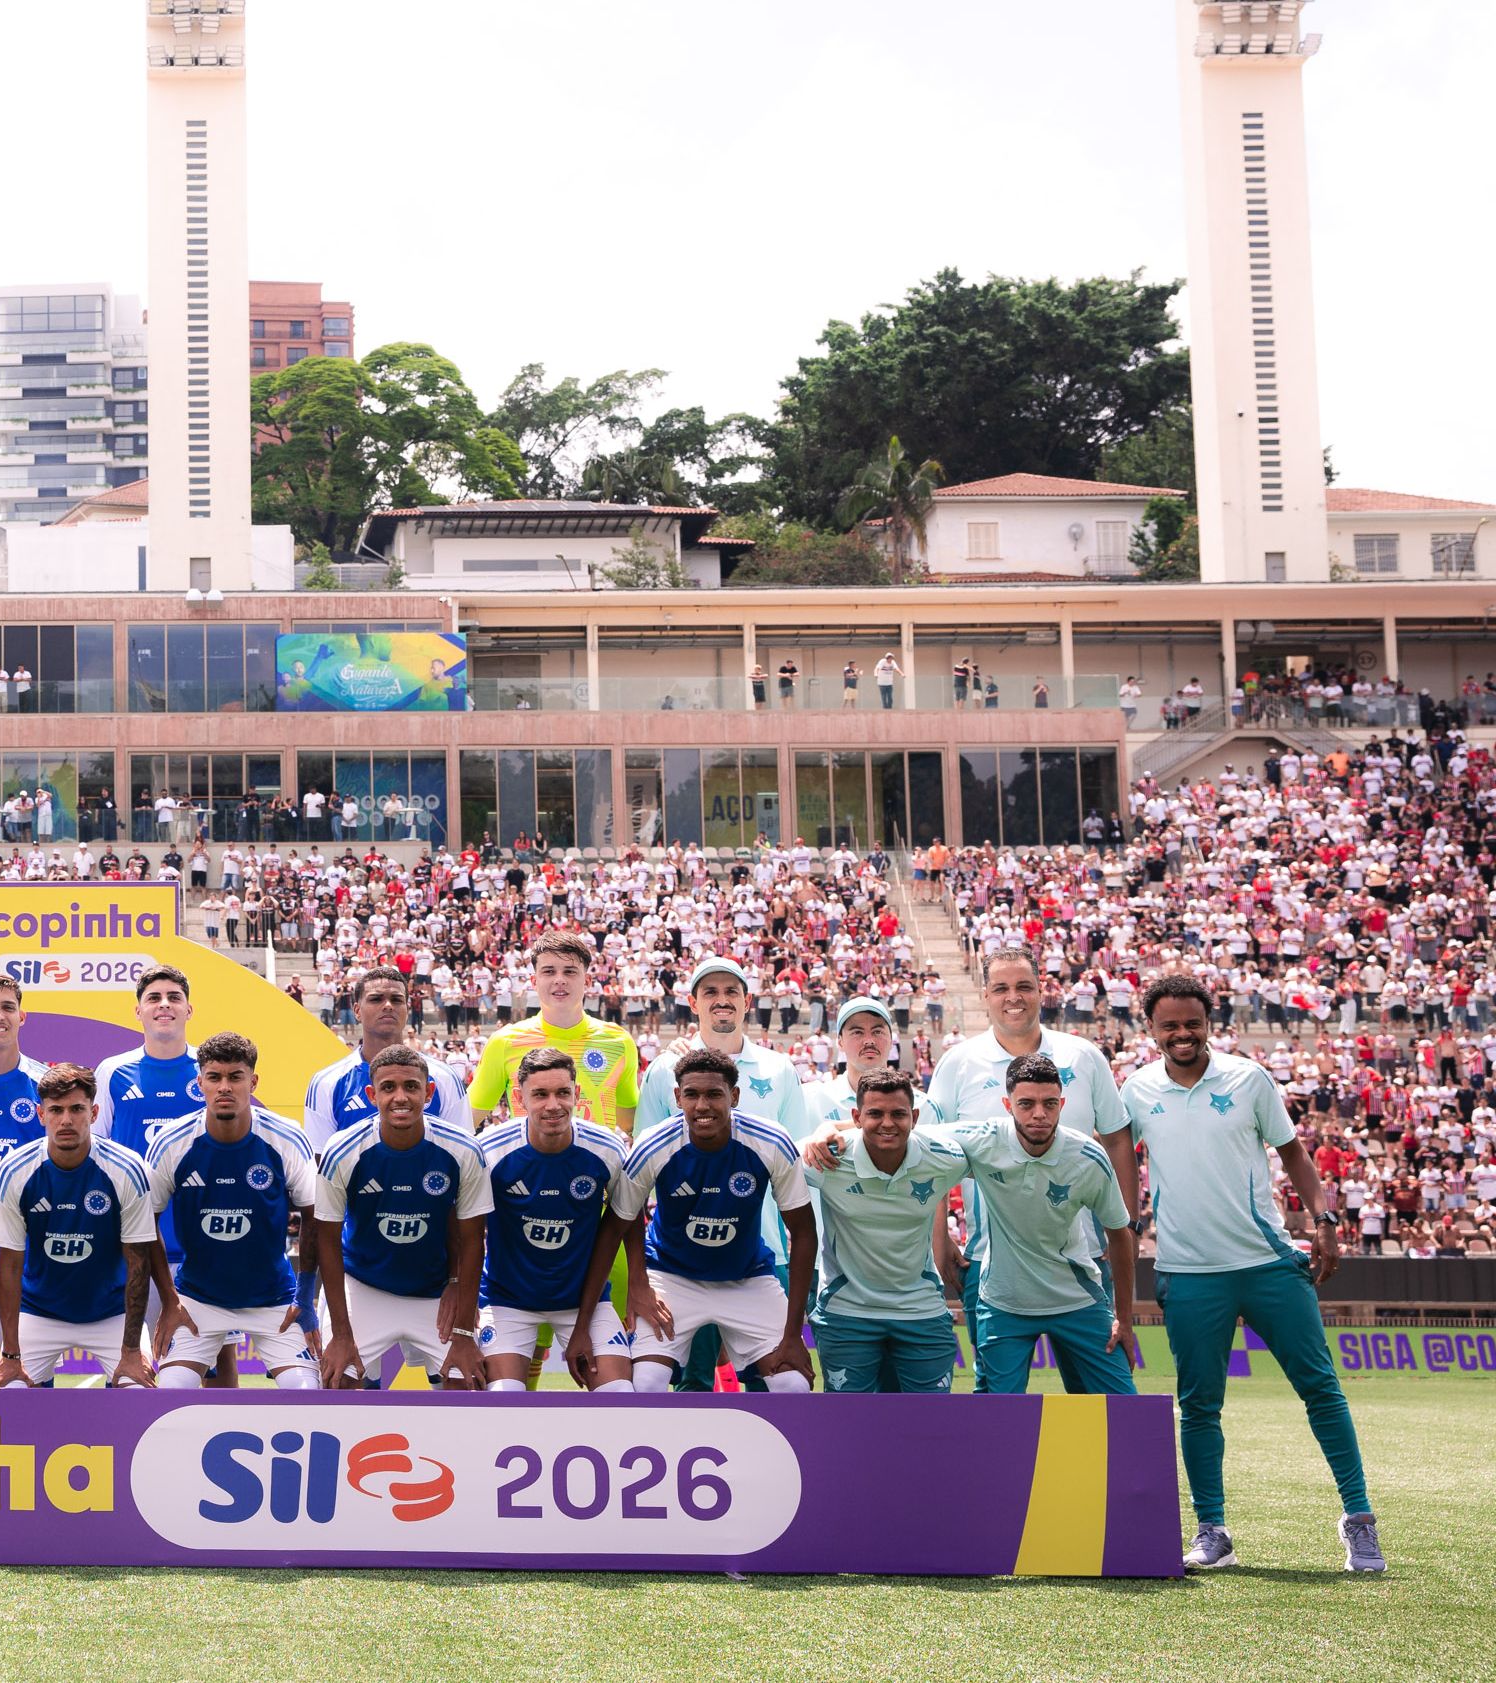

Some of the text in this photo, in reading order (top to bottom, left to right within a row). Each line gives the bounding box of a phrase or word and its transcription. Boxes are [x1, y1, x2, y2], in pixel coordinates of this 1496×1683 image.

[705, 795, 753, 826] AÇO
[6, 960, 143, 983] Sil 2026
[209, 1216, 243, 1233] BH
[386, 1220, 421, 1237] BH
[693, 1224, 729, 1240] BH
[530, 1225, 565, 1243] BH
[50, 1240, 84, 1256] BH
[1338, 1333, 1496, 1372] SIGA @CO
[199, 1431, 340, 1523] Sil
[495, 1445, 732, 1521] 2026
